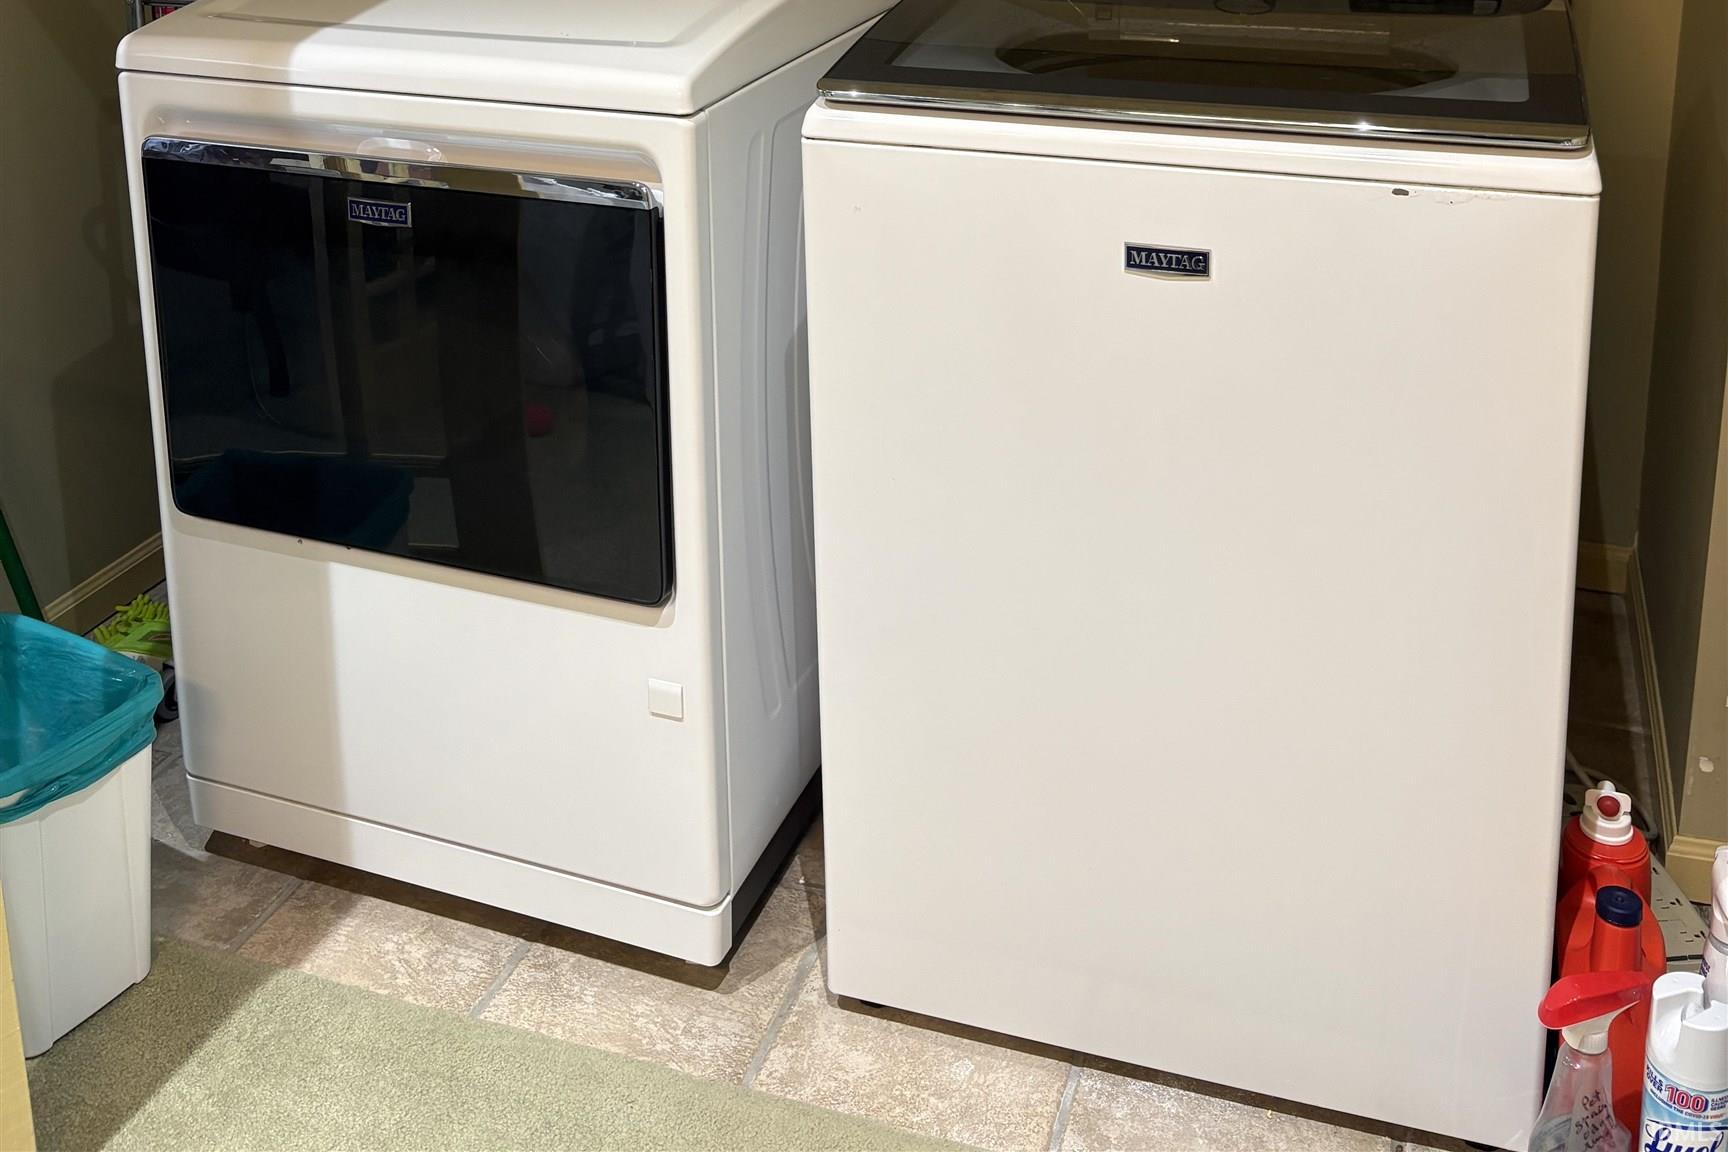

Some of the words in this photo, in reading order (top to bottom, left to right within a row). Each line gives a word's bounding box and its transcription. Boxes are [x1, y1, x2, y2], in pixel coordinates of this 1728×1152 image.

[351, 203, 406, 221] MAYTAG
[1129, 250, 1206, 271] MAYTAG
[1665, 1084, 1709, 1114] 100
